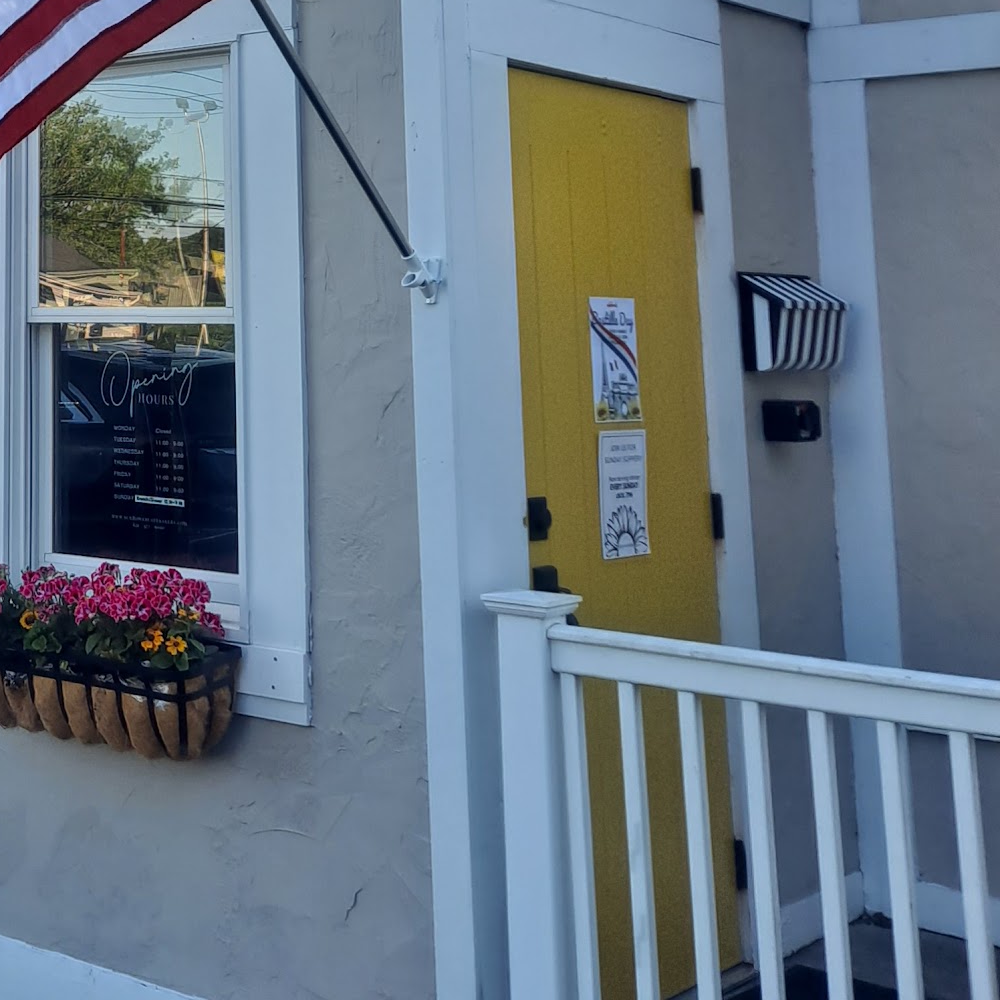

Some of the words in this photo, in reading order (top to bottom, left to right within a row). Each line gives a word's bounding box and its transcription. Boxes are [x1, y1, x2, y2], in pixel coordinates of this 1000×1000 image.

[101, 351, 198, 417] Opening
[138, 393, 174, 405] HOURS
[113, 447, 144, 455] WEDNESDAY
